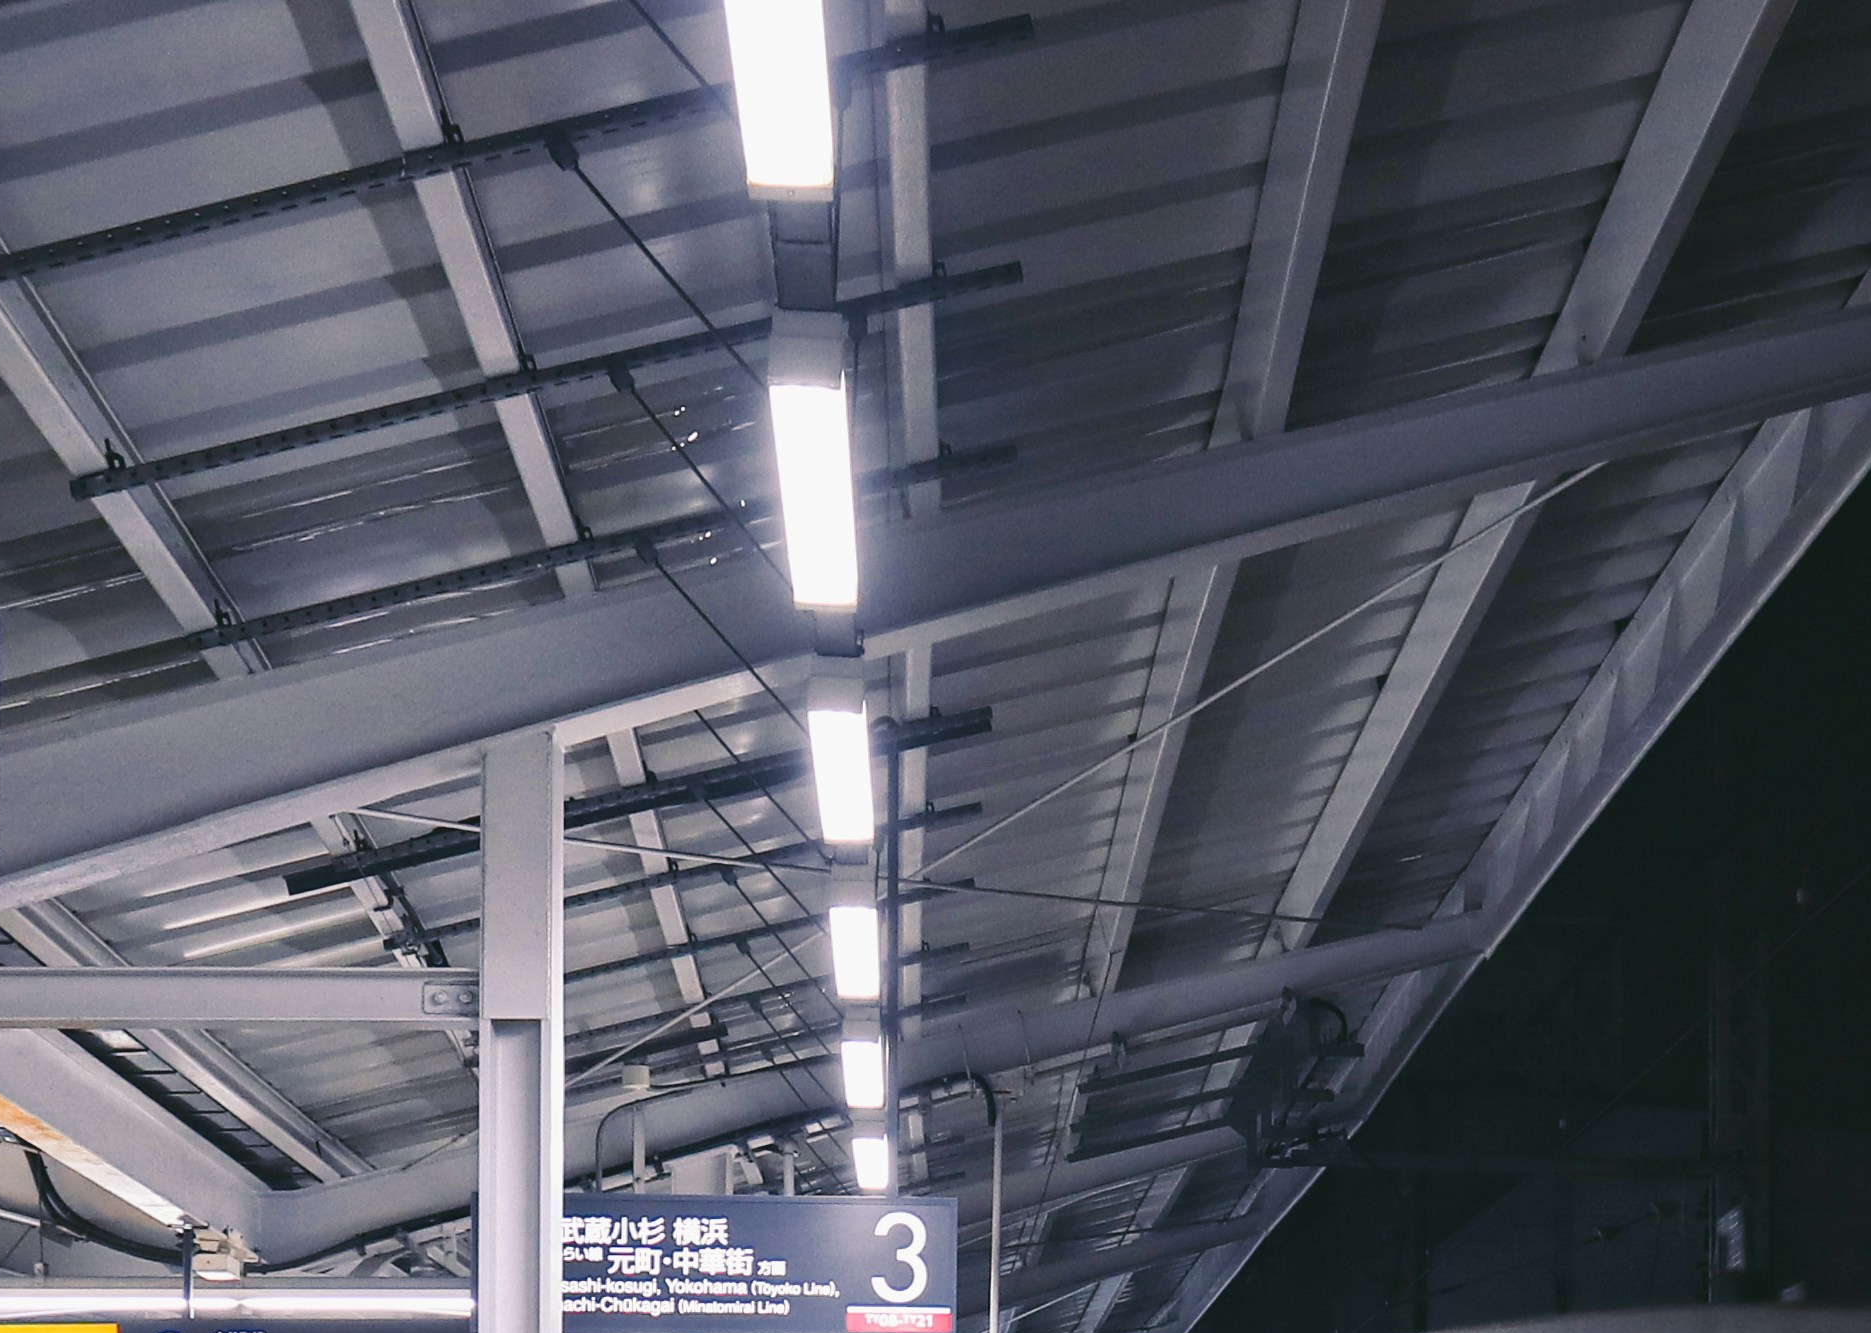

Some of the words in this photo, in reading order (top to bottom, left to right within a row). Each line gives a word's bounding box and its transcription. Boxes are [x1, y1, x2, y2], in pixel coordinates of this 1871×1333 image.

[561, 1216, 665, 1246] 武蔵小杉
[673, 1217, 728, 1246] 横浜
[562, 1248, 603, 1262] らい線
[608, 1247, 754, 1276] 元町・中華街
[871, 1211, 928, 1304] 3
[560, 1278, 661, 1297] sashi-kosugi,
[667, 1278, 747, 1296] Yokohama
[561, 1296, 675, 1317] achi-Chūkagai
[757, 1299, 791, 1315] Line)
